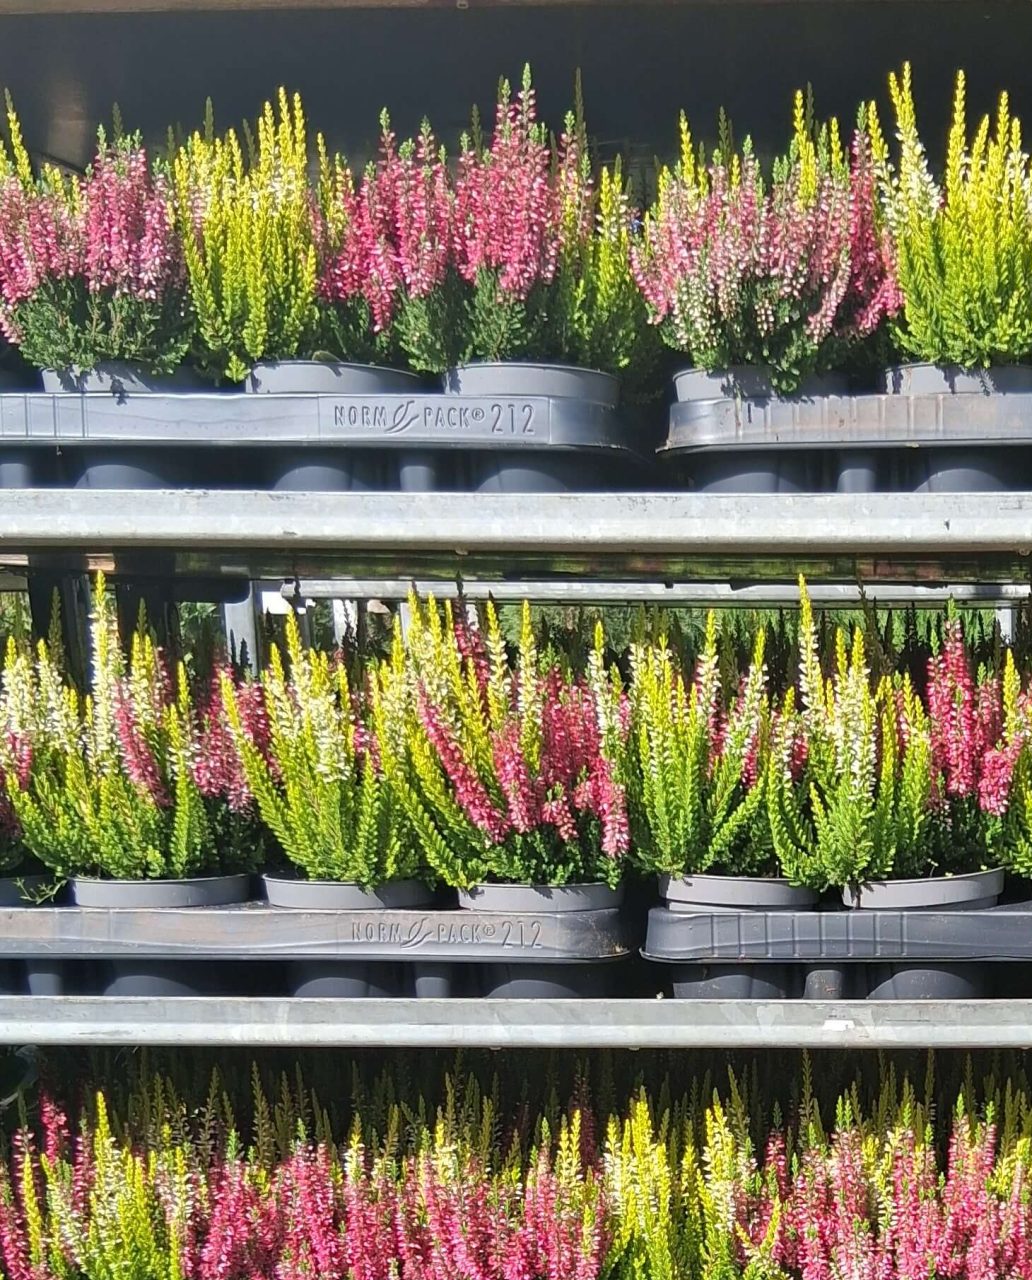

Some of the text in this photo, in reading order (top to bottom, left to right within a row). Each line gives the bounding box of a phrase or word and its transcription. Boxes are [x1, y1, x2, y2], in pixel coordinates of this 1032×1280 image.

[334, 404, 388, 428] NORM
[490, 403, 535, 434] 212
[351, 921, 402, 943] NORM
[501, 920, 543, 949] 212
